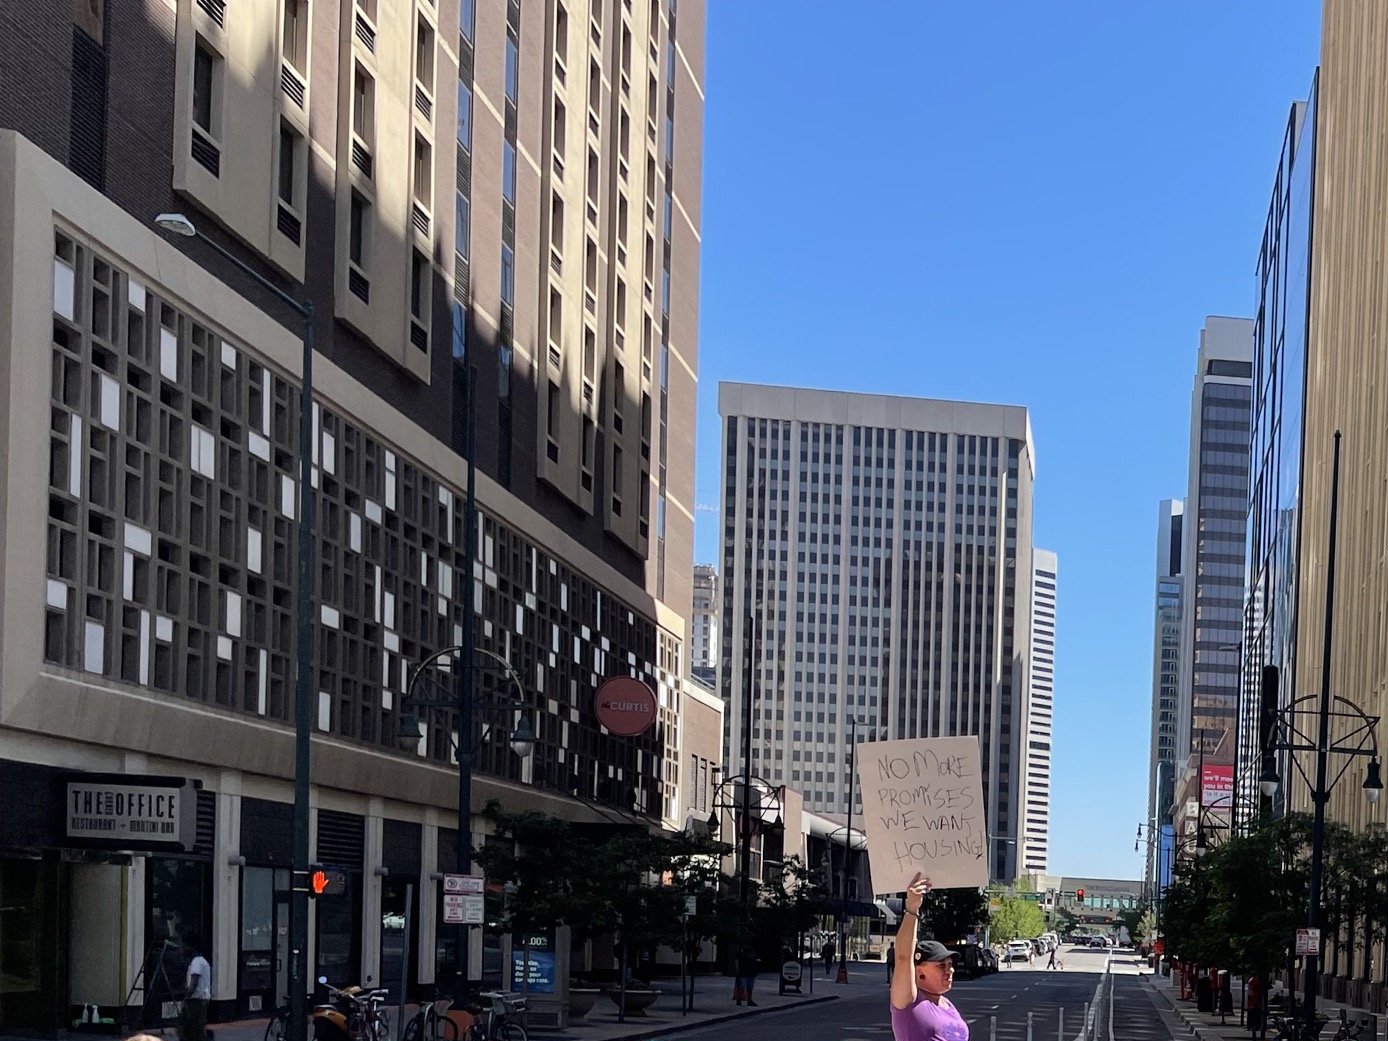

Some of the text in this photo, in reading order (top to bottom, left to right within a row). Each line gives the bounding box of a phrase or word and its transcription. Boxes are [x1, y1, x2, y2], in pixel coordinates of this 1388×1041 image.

[610, 701, 650, 713] CURTIS
[878, 755, 910, 780] NO
[72, 790, 103, 815] THE
[115, 792, 175, 819] OFFICE
[71, 817, 116, 831] RESTAURANT
[880, 810, 919, 831] WE
